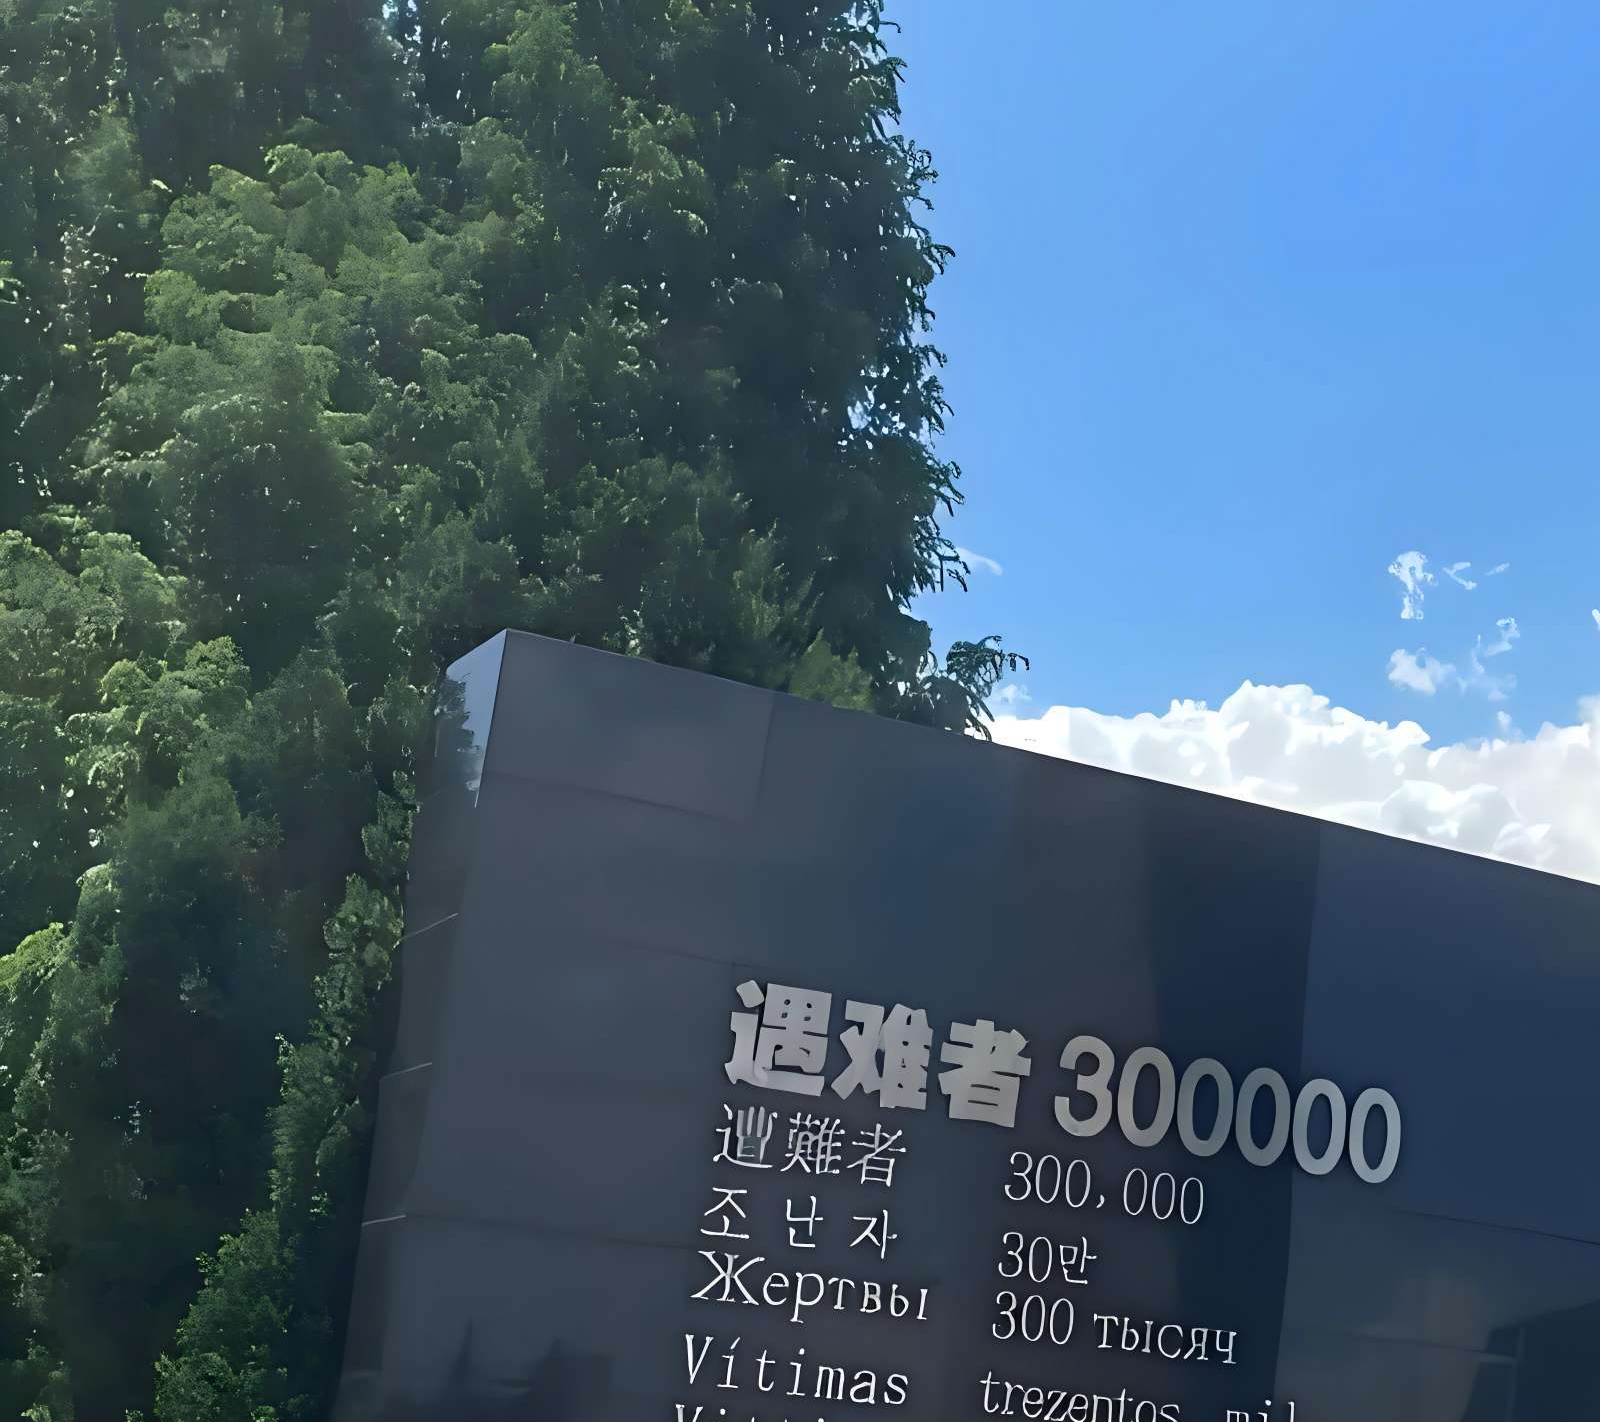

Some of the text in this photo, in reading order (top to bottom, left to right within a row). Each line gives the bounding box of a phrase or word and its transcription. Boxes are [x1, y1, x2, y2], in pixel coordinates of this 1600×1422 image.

[723, 979, 1402, 1183] 遇难者 300000
[997, 1231, 1098, 1285] 30만
[690, 1250, 1238, 1365] Жертвы 300 тысяч
[684, 1333, 909, 1405] Vítimas
